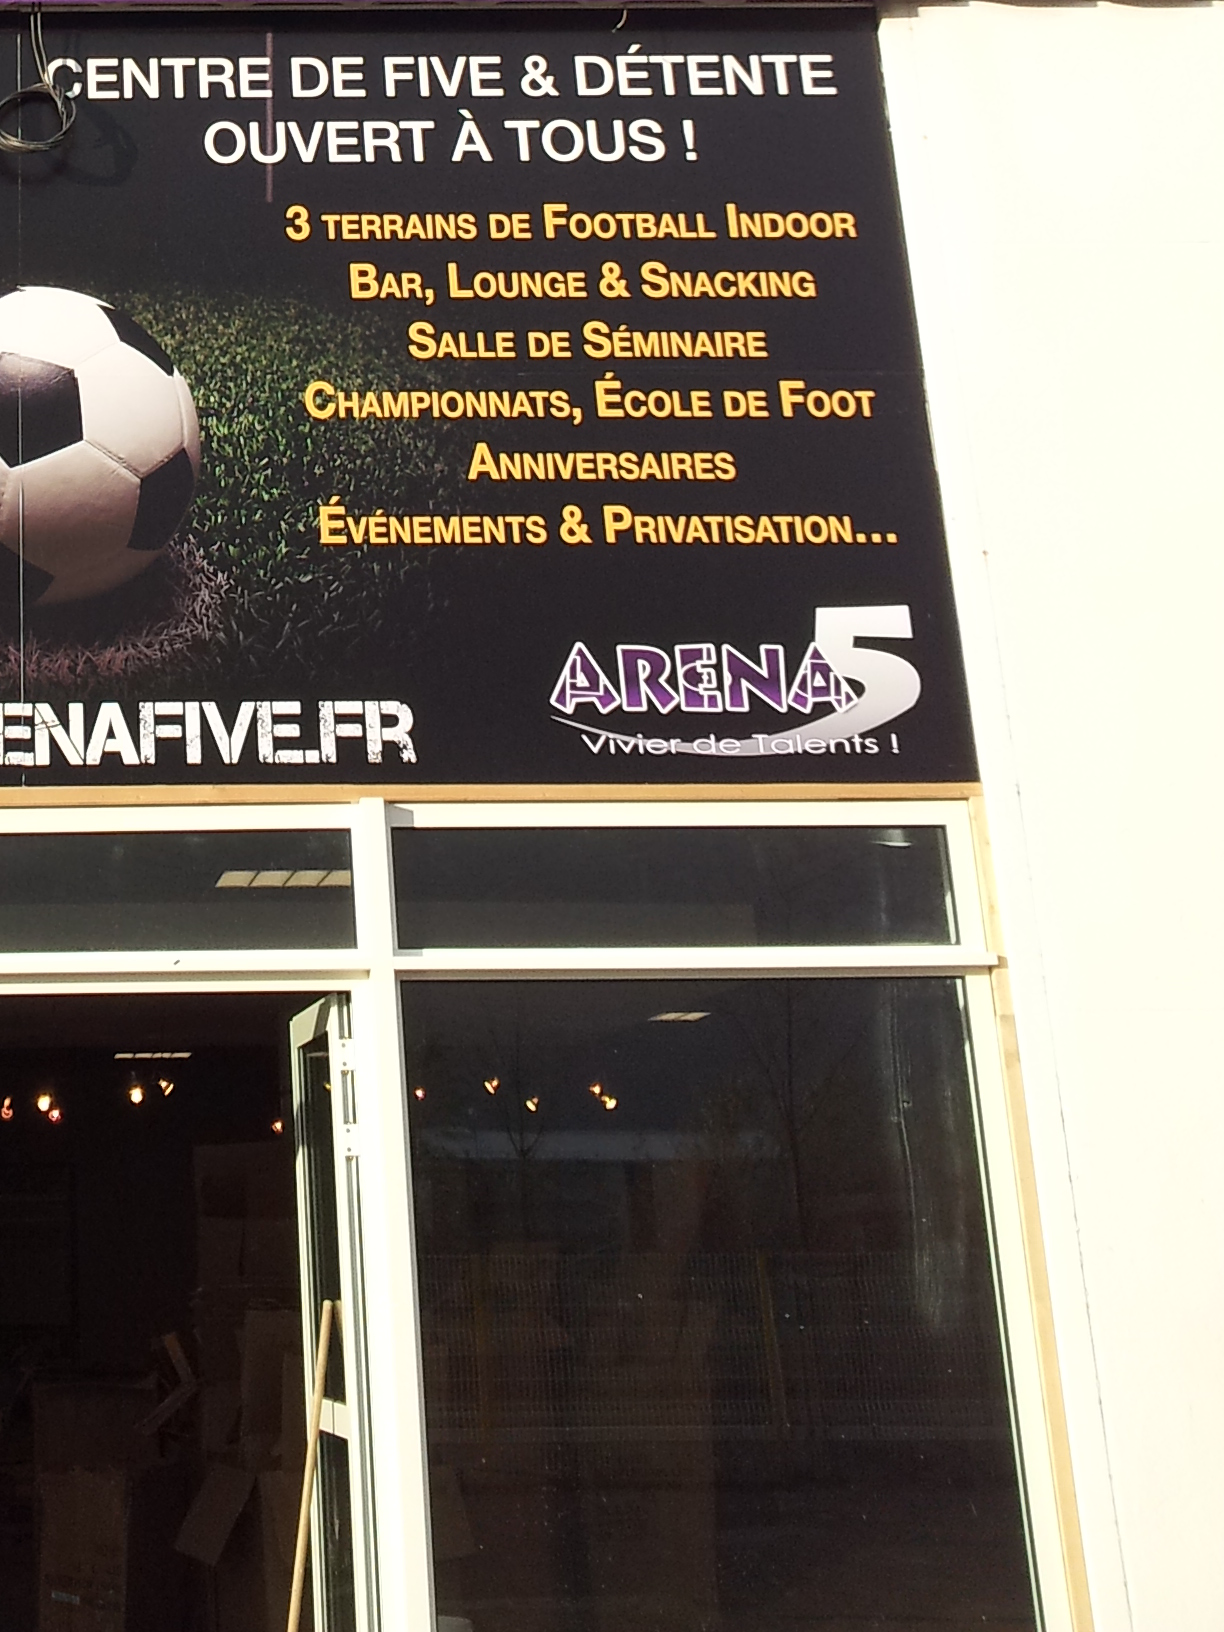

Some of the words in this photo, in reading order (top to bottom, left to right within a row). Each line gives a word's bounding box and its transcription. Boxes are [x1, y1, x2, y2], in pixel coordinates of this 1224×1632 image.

[47, 57, 273, 100] CENTRE
[290, 56, 367, 99] DE
[384, 55, 506, 99] FIVE
[520, 54, 561, 98] &
[574, 43, 839, 97] DÉTENTE
[203, 121, 436, 164] OUVERT
[451, 109, 494, 162] À
[504, 119, 667, 163] TOUS
[682, 119, 700, 162] !
[285, 204, 311, 241] 3
[598, 260, 631, 299] &
[559, 505, 593, 545] &
[550, 641, 859, 714] ARENA
[580, 734, 681, 756] Vivier
[692, 734, 742, 754] de
[750, 733, 880, 755] Talents
